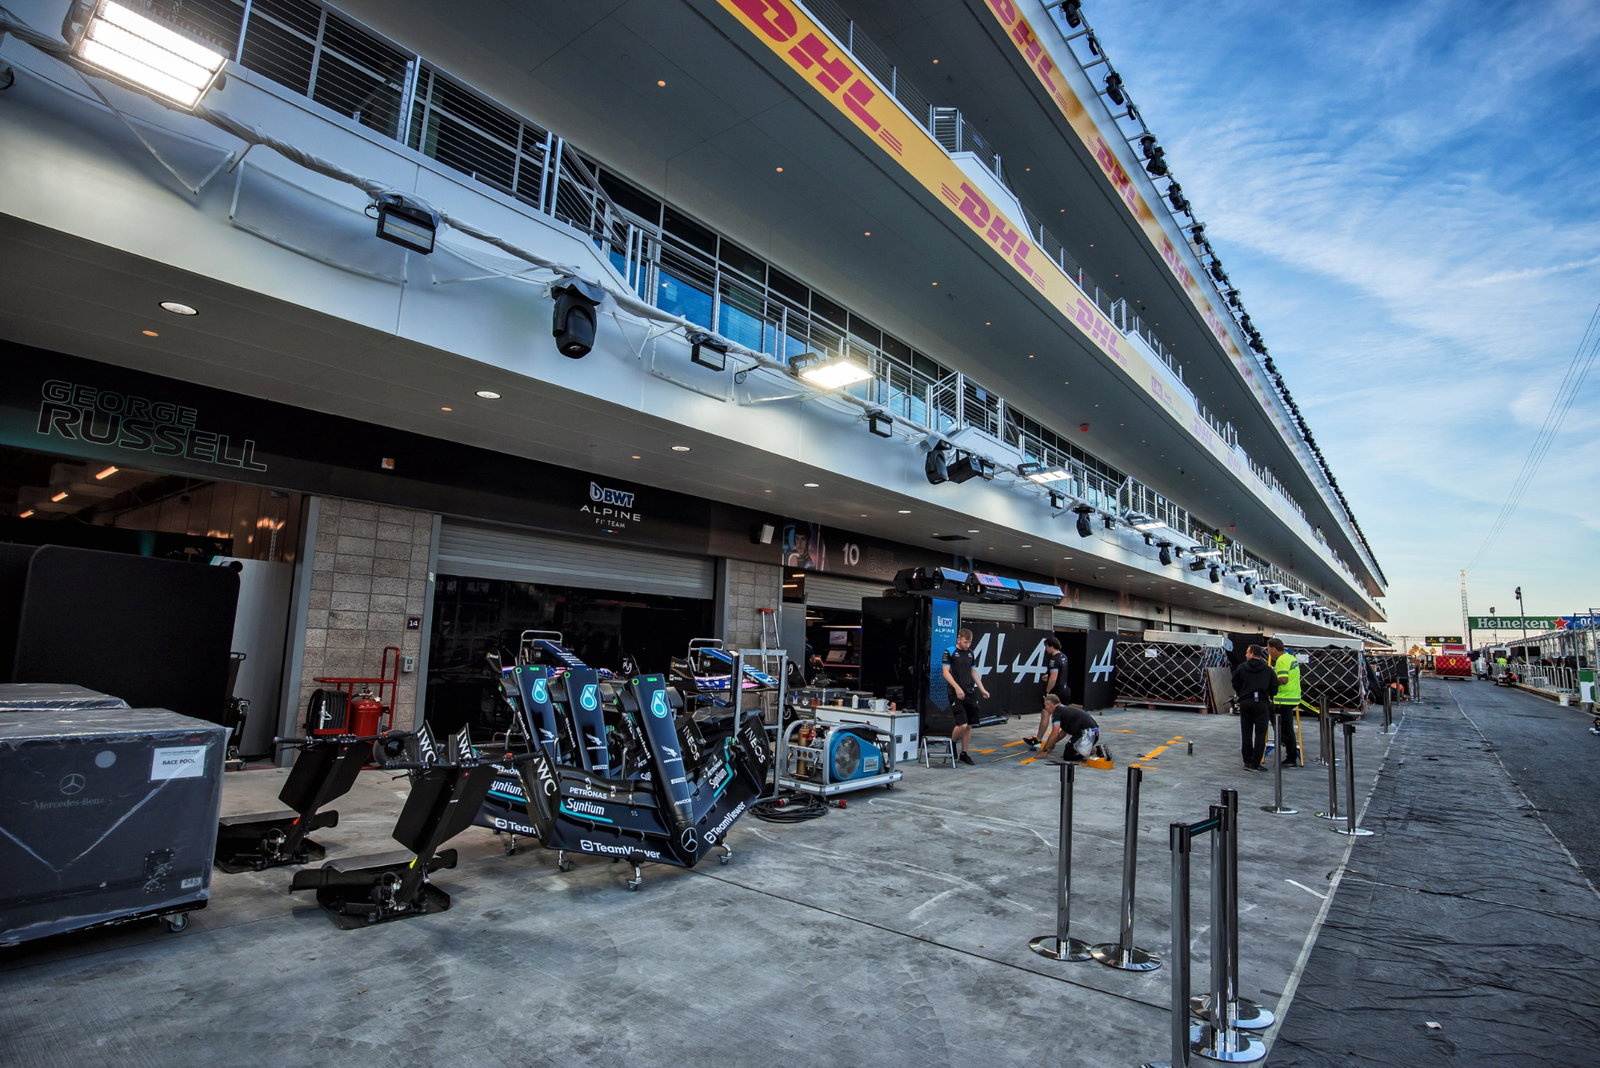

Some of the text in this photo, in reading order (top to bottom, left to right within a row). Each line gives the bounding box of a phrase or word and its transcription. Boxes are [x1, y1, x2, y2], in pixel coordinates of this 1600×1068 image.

[989, 0, 1057, 93] DHL
[731, 0, 881, 132] DHL
[1096, 136, 1139, 215] DHL
[958, 182, 1034, 278] DHL
[1076, 297, 1121, 360] DHL
[42, 379, 198, 429] GEORGE
[37, 400, 268, 472] RUSSELL
[580, 504, 641, 522] ALPINE
[603, 487, 635, 509] BWT
[607, 520, 625, 529] TEAM
[842, 542, 860, 567] 10
[1477, 617, 1550, 630] Heineken
[416, 725, 437, 763] IWC
[682, 725, 701, 762] INEOS
[744, 727, 766, 764] INEOS
[569, 786, 608, 800] PETRONAS
[708, 767, 728, 790] Syntium
[566, 797, 605, 816] Syntium
[711, 800, 747, 837] TeamViewer
